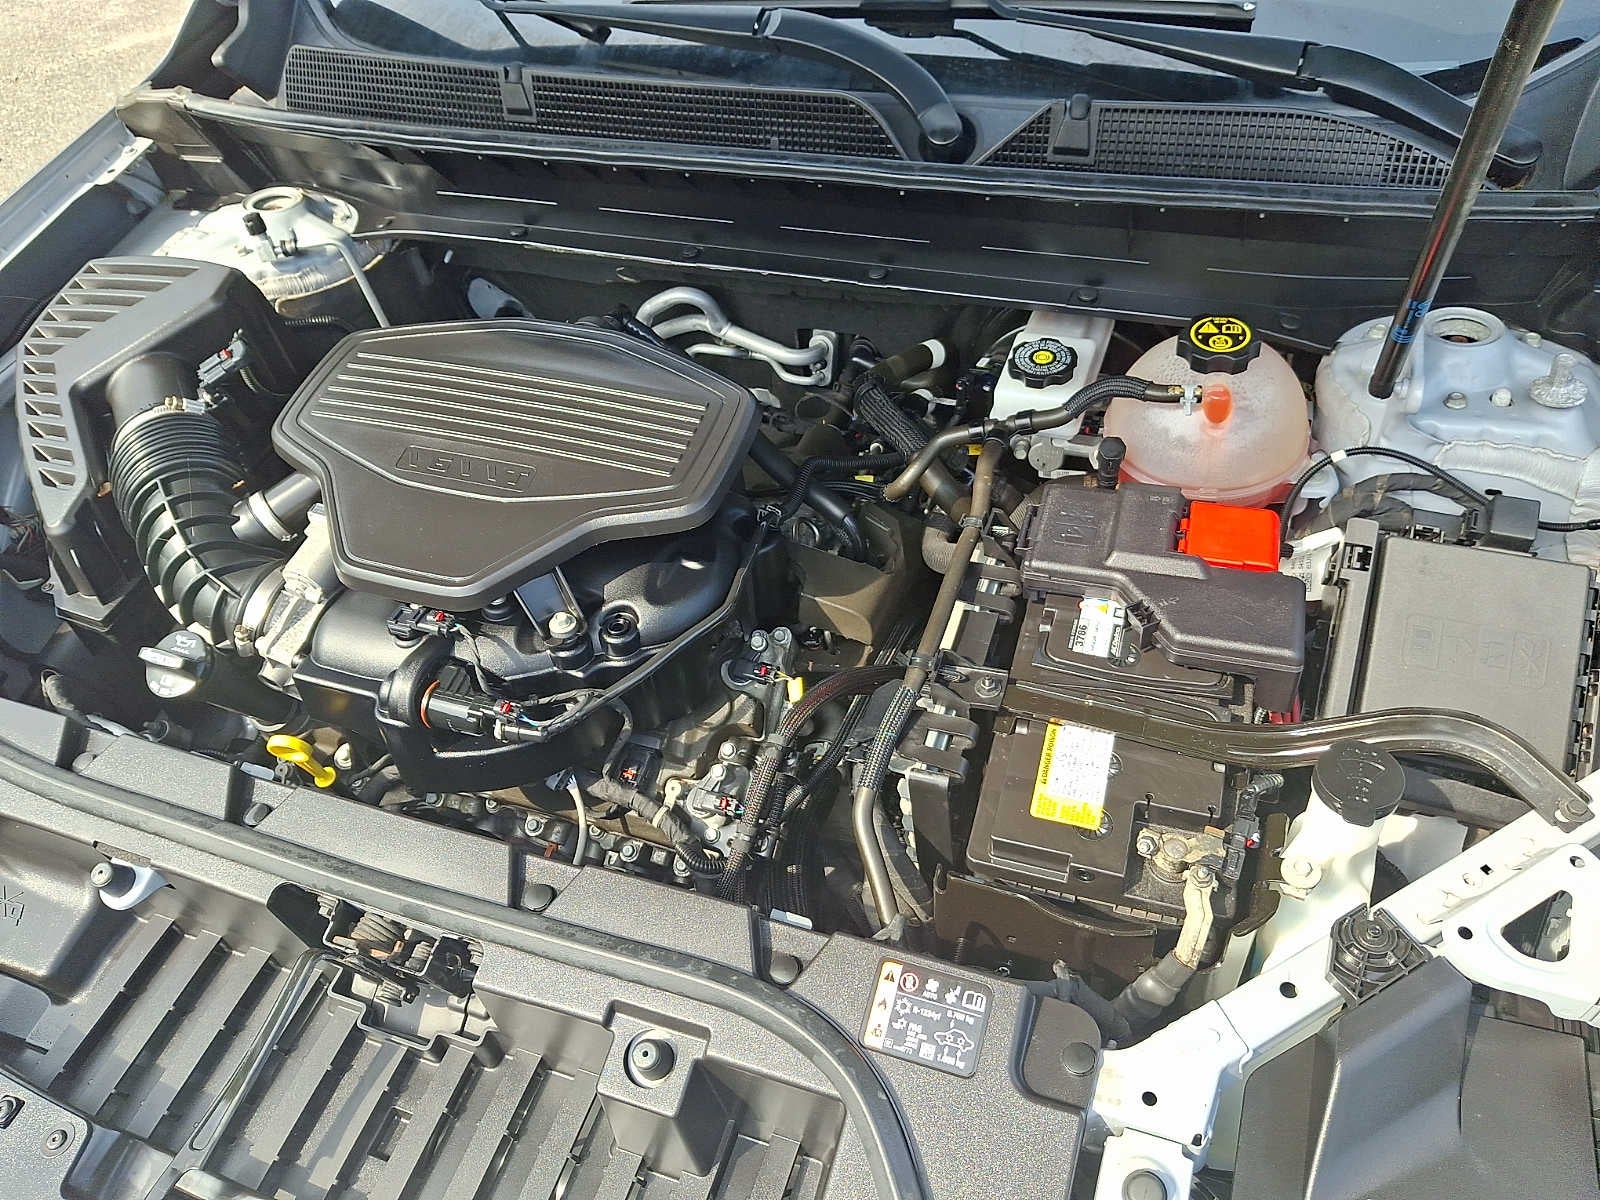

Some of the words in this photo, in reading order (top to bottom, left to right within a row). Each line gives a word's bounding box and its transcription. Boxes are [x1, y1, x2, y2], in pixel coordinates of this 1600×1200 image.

[1075, 624, 1088, 647] 3786
[1110, 626, 1122, 656] ACDelco
[1041, 752, 1053, 778] DANGER
[1047, 728, 1057, 752] POISON
